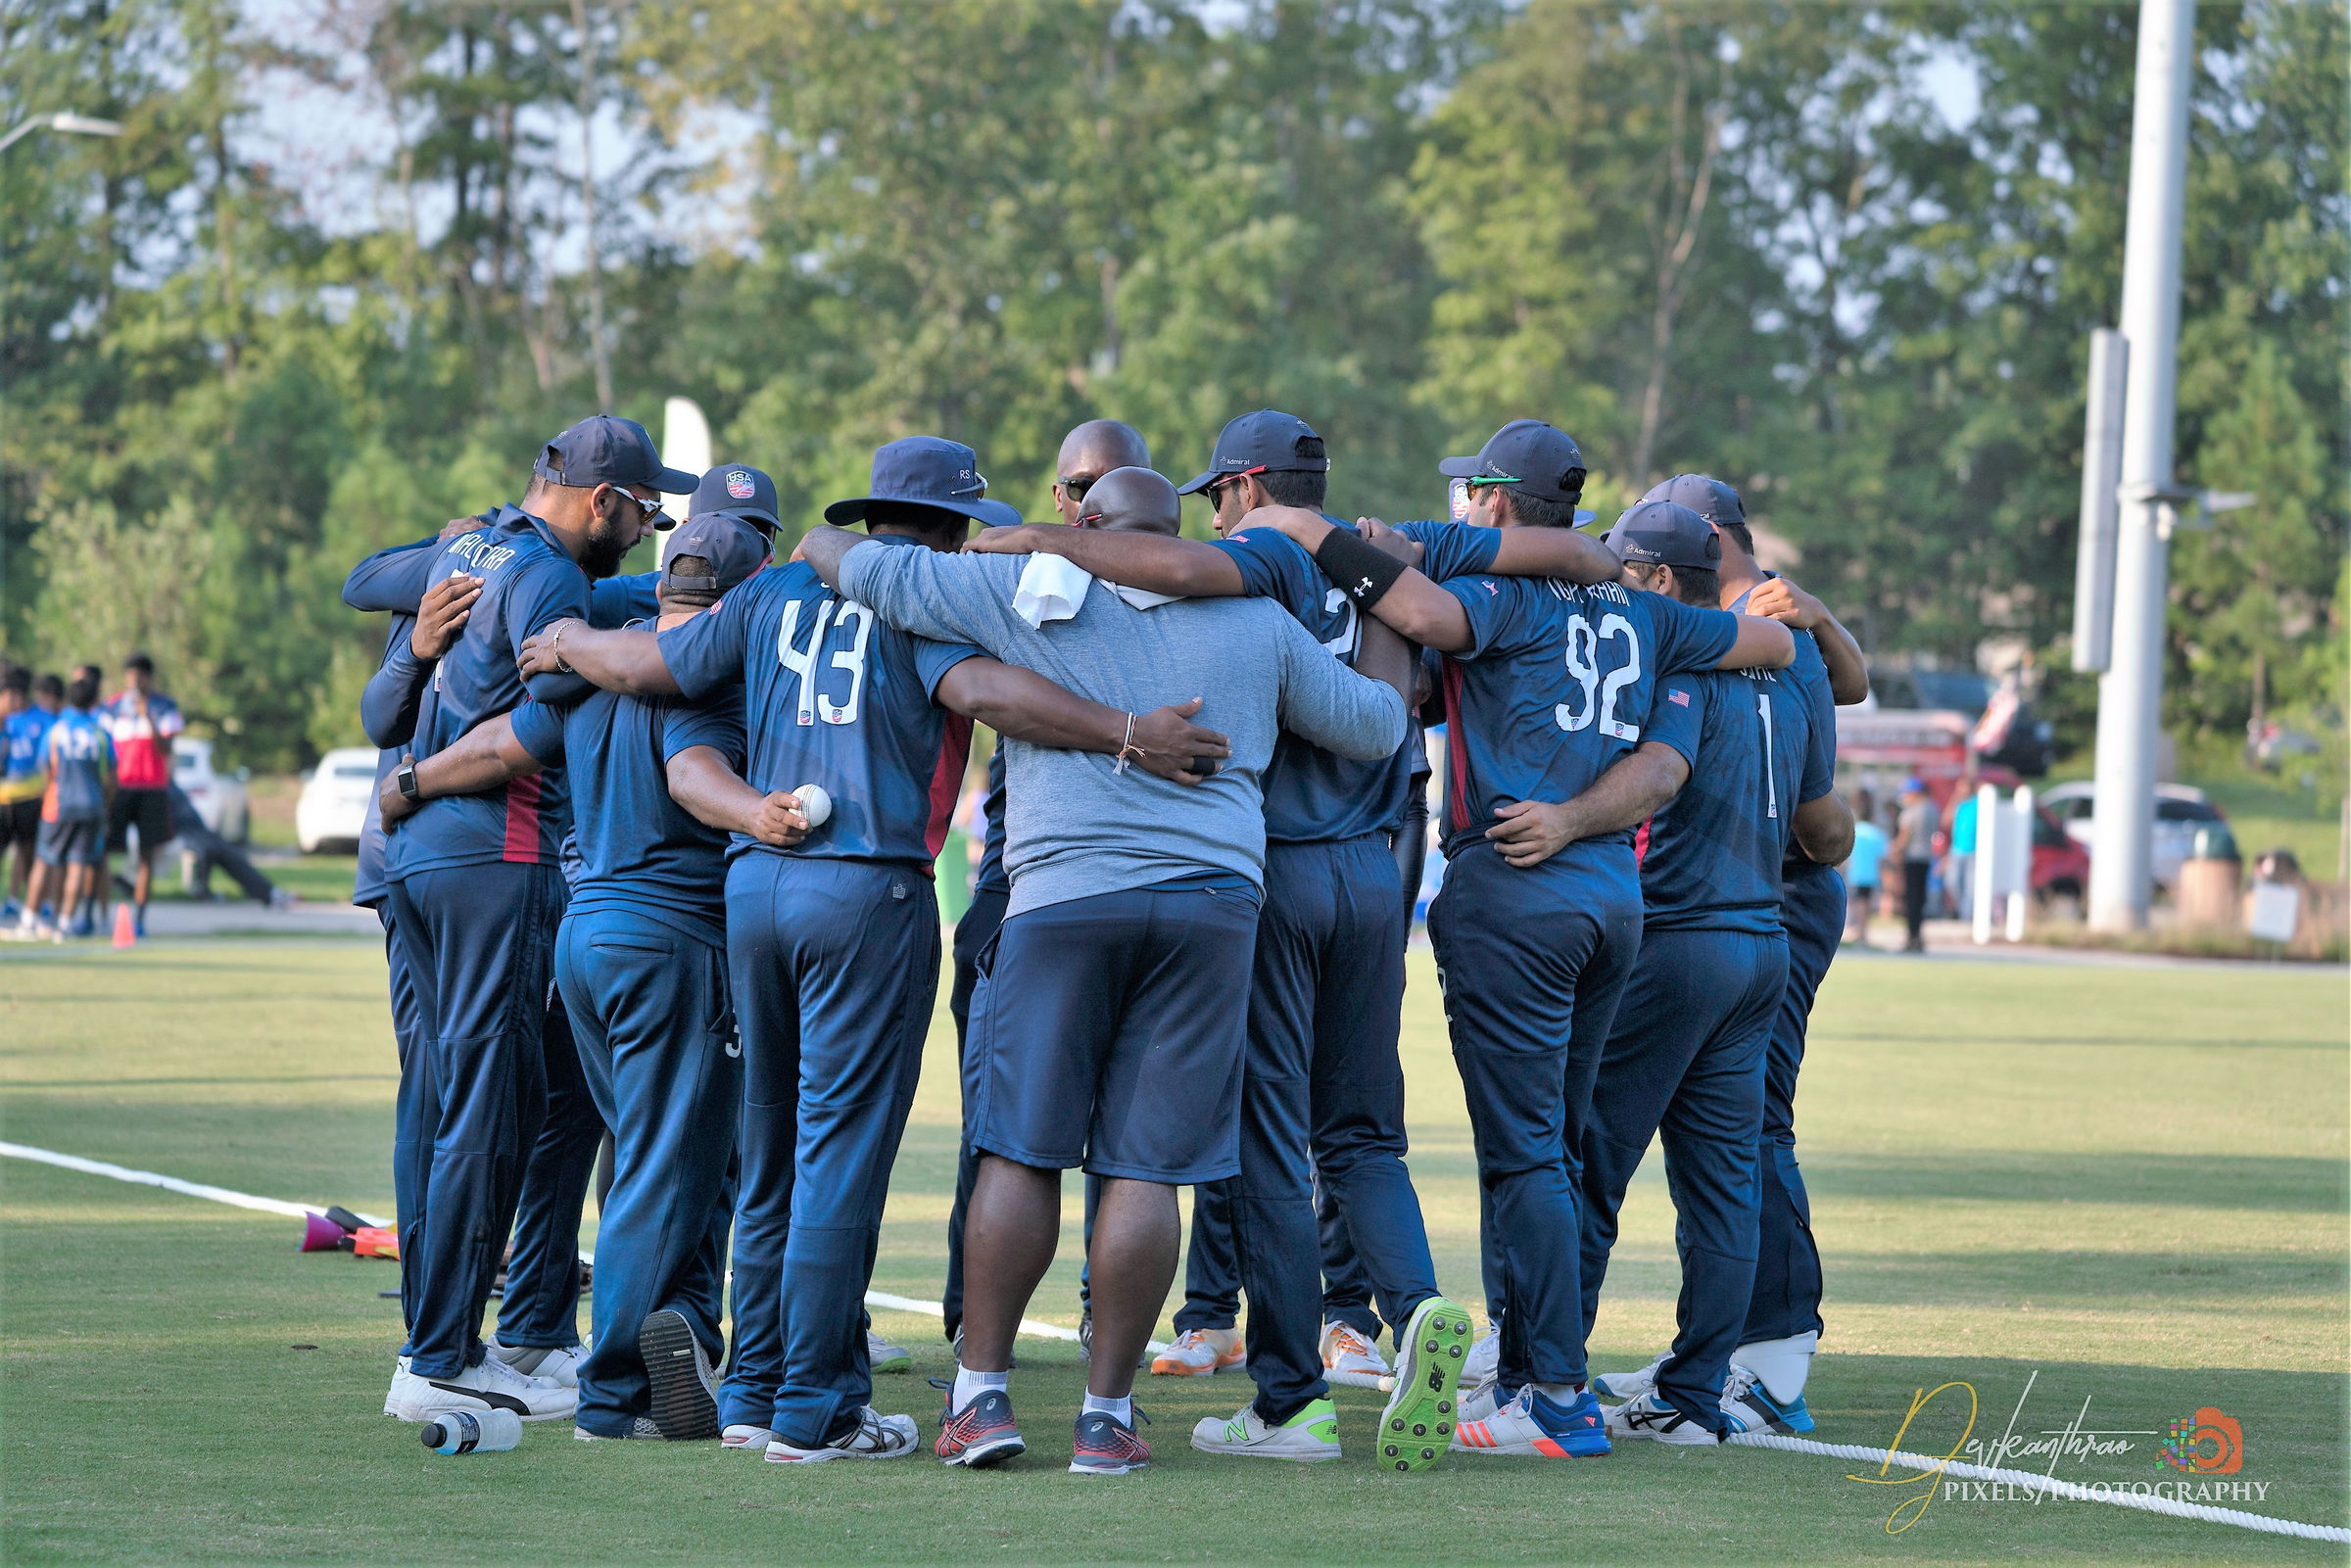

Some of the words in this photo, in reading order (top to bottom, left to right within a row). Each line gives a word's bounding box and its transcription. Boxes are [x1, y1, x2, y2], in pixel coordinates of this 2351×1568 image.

[729, 472, 752, 482] USA
[959, 469, 971, 480] RS
[1634, 547, 1661, 558] Admiral
[777, 599, 875, 727] 43
[1555, 613, 1642, 742] 92
[1757, 693, 1778, 819] 1
